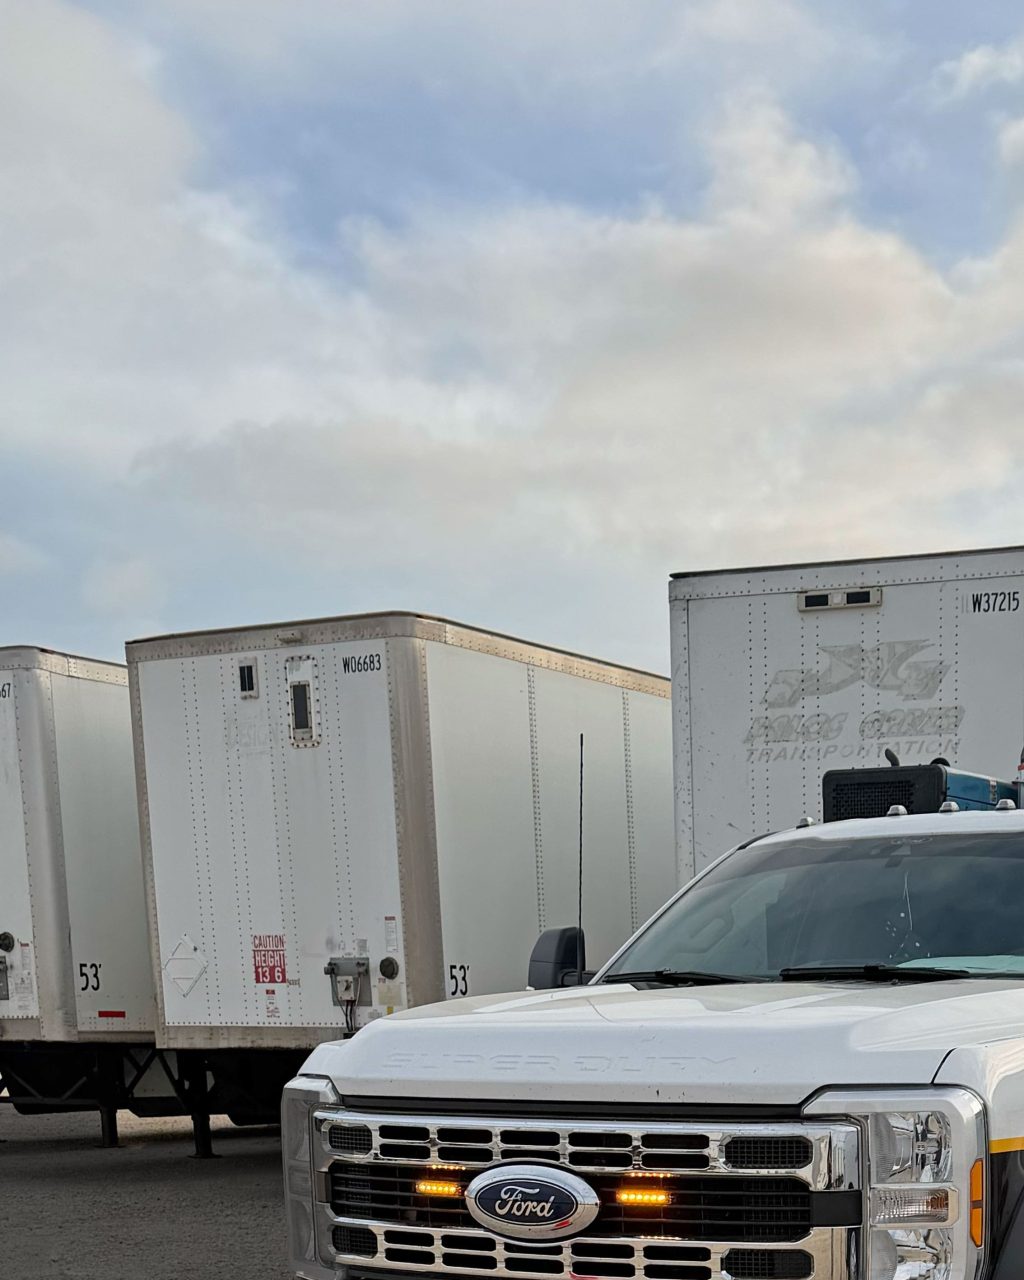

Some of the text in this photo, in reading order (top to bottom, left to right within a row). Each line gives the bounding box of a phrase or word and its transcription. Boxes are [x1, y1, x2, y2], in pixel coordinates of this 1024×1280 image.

[971, 591, 1020, 614] W37215
[342, 653, 382, 674] W06683
[0, 682, 11, 699] 67
[253, 934, 285, 949] CAUTION
[255, 950, 285, 968] HEIGHT
[79, 963, 102, 991] 53'
[258, 967, 270, 983] 13
[274, 967, 283, 983] 6
[449, 965, 470, 996] 53'
[494, 1185, 555, 1218] Ford
